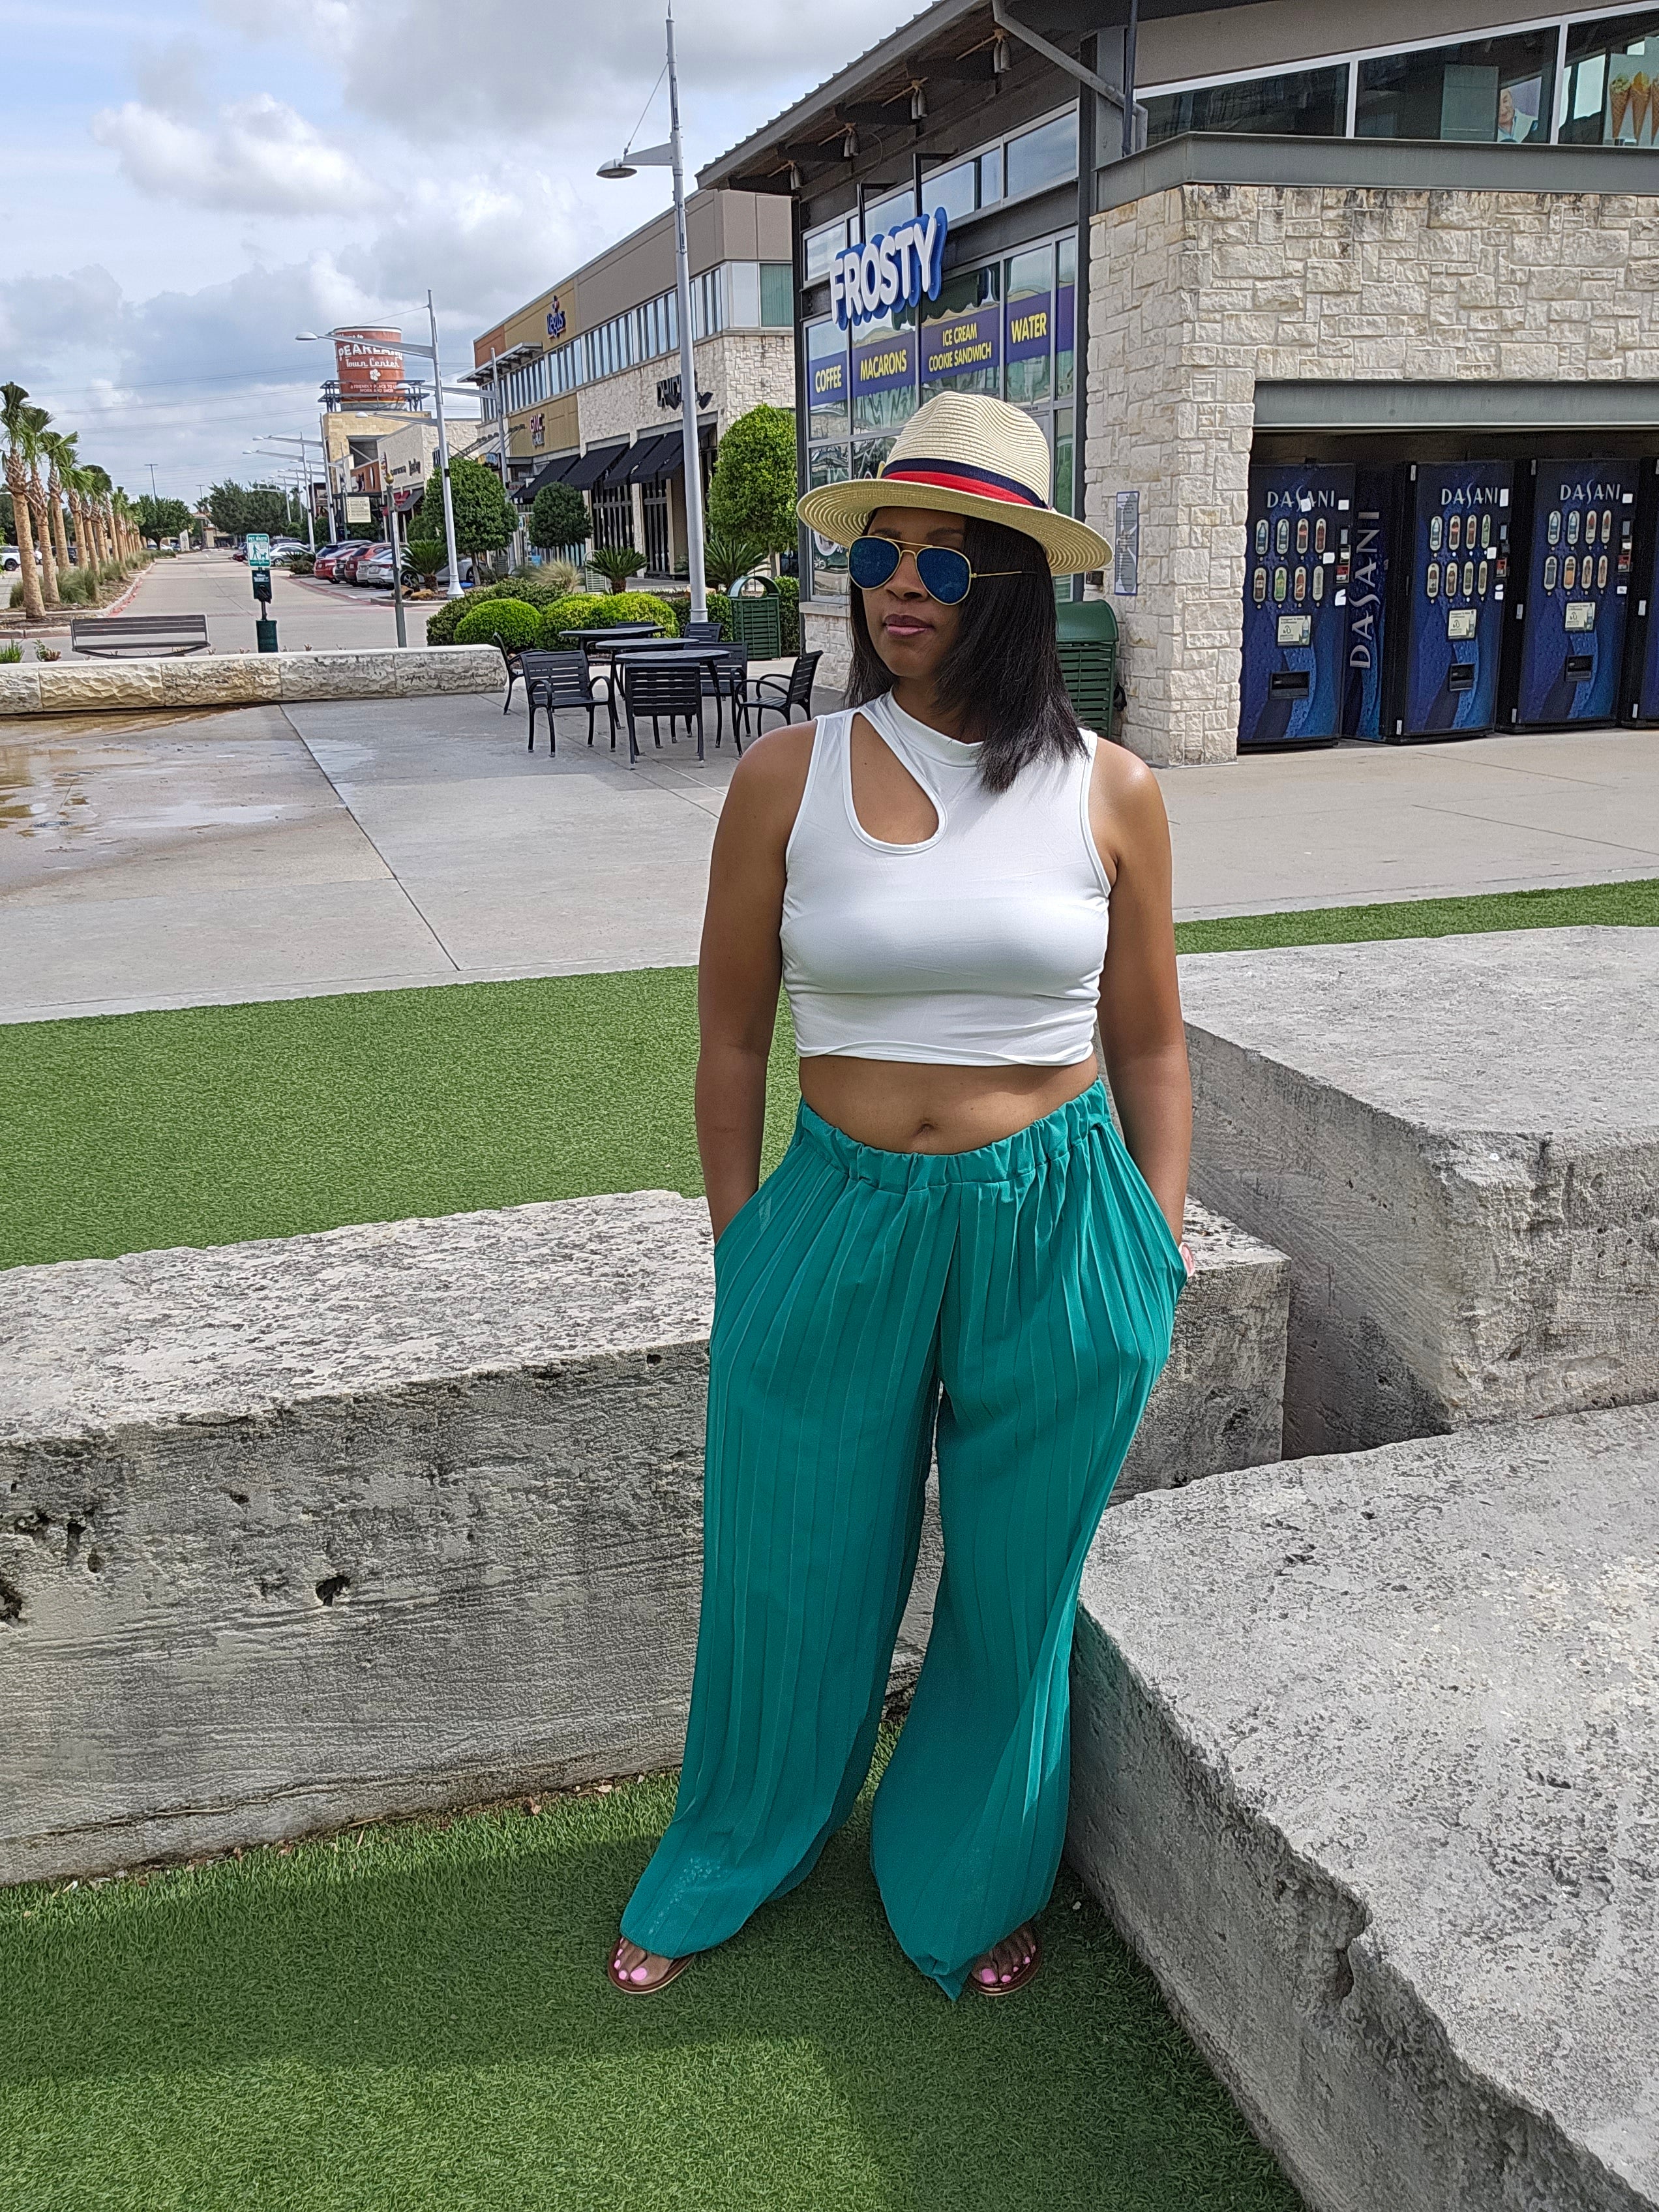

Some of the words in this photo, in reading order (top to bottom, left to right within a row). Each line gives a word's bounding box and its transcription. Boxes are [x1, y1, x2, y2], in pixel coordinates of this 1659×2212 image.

[830, 215, 937, 325] FROSTY
[942, 328, 953, 347] ICE
[953, 323, 977, 344] CREAM
[1011, 312, 1047, 344] WATER
[338, 344, 403, 361] PEARLA
[346, 359, 368, 368] Town
[369, 357, 400, 368] Center
[859, 349, 907, 381] MACARONS
[929, 351, 953, 372] COOKIE
[954, 342, 991, 367] SANDWICH
[815, 365, 842, 393] COFFEE
[530, 413, 545, 432] GNC
[1267, 485, 1335, 513] DASANI
[1441, 480, 1499, 509] DASANI
[1560, 479, 1621, 505] DASANI
[1349, 511, 1381, 668] DASANI
